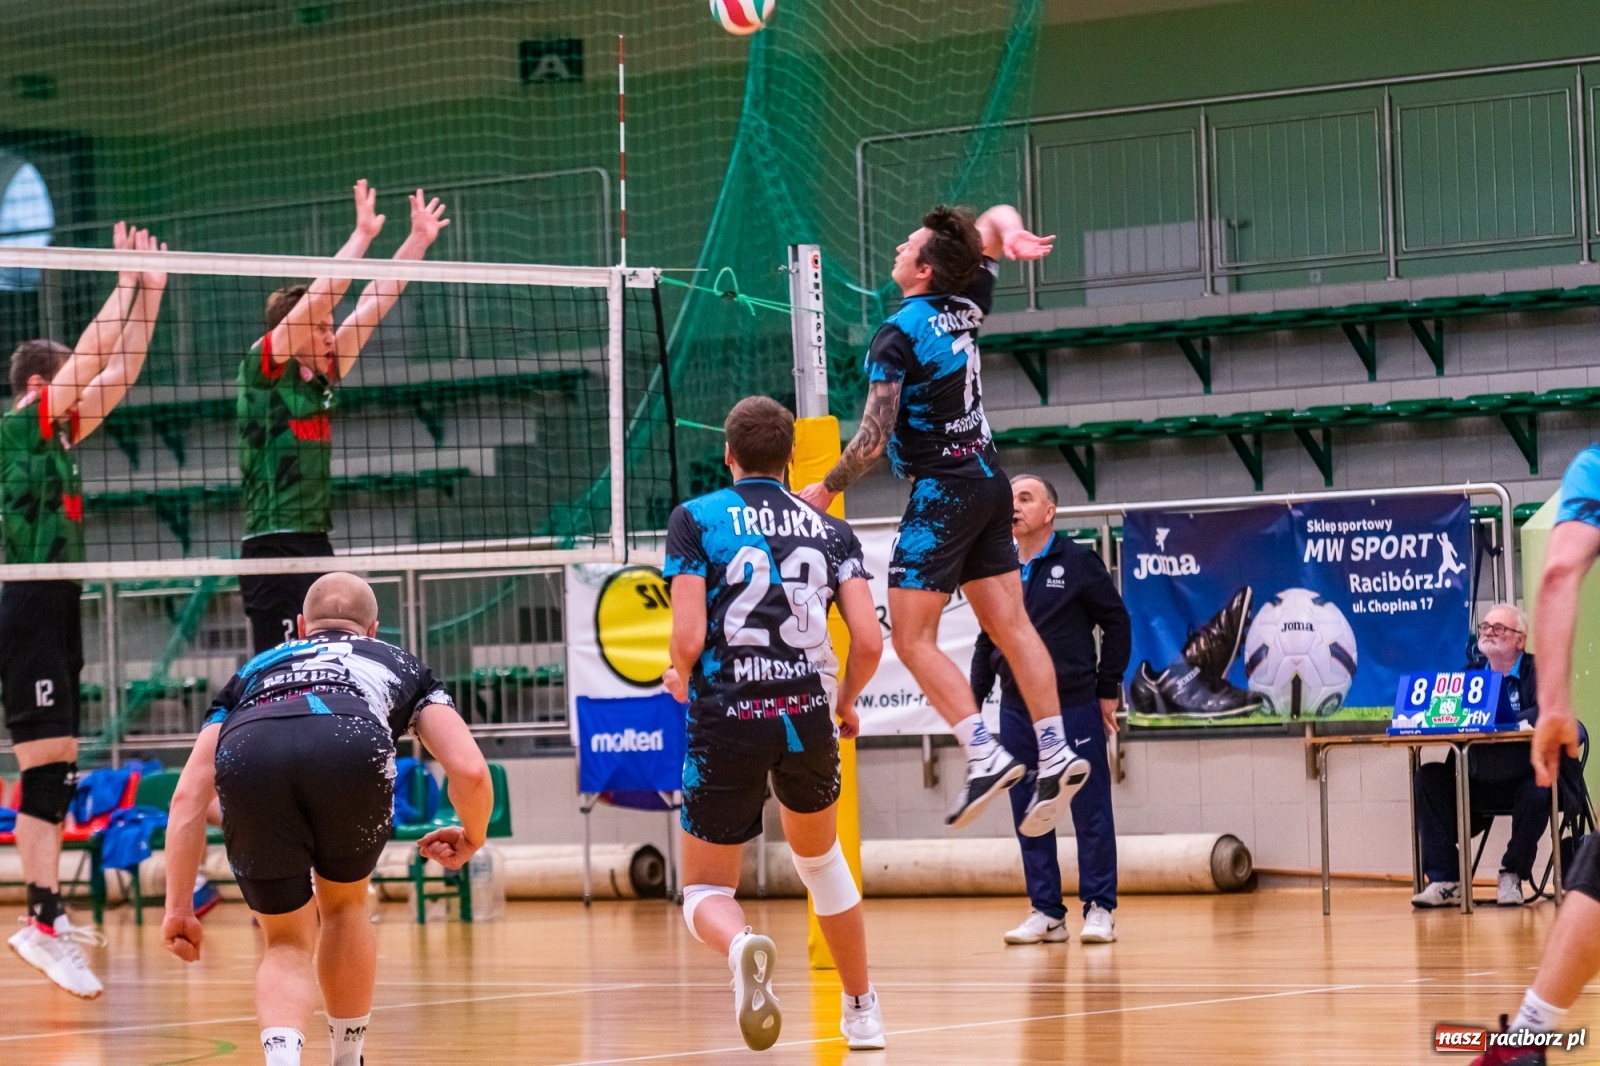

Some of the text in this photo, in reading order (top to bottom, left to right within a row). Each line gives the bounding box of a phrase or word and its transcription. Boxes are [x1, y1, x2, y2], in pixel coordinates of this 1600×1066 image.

[529, 54, 570, 81] A
[727, 500, 827, 539] TRÓJKA
[1307, 519, 1393, 535] Sklep sportowy
[1303, 534, 1433, 563] MW SPORT
[1349, 568, 1433, 593] Racibórz
[724, 546, 828, 649] 23
[1352, 597, 1433, 615] ul. Chopina 17
[35, 679, 54, 707] 12
[1410, 678, 1428, 705] 8
[1467, 676, 1484, 704] 8
[591, 728, 664, 752] molten
